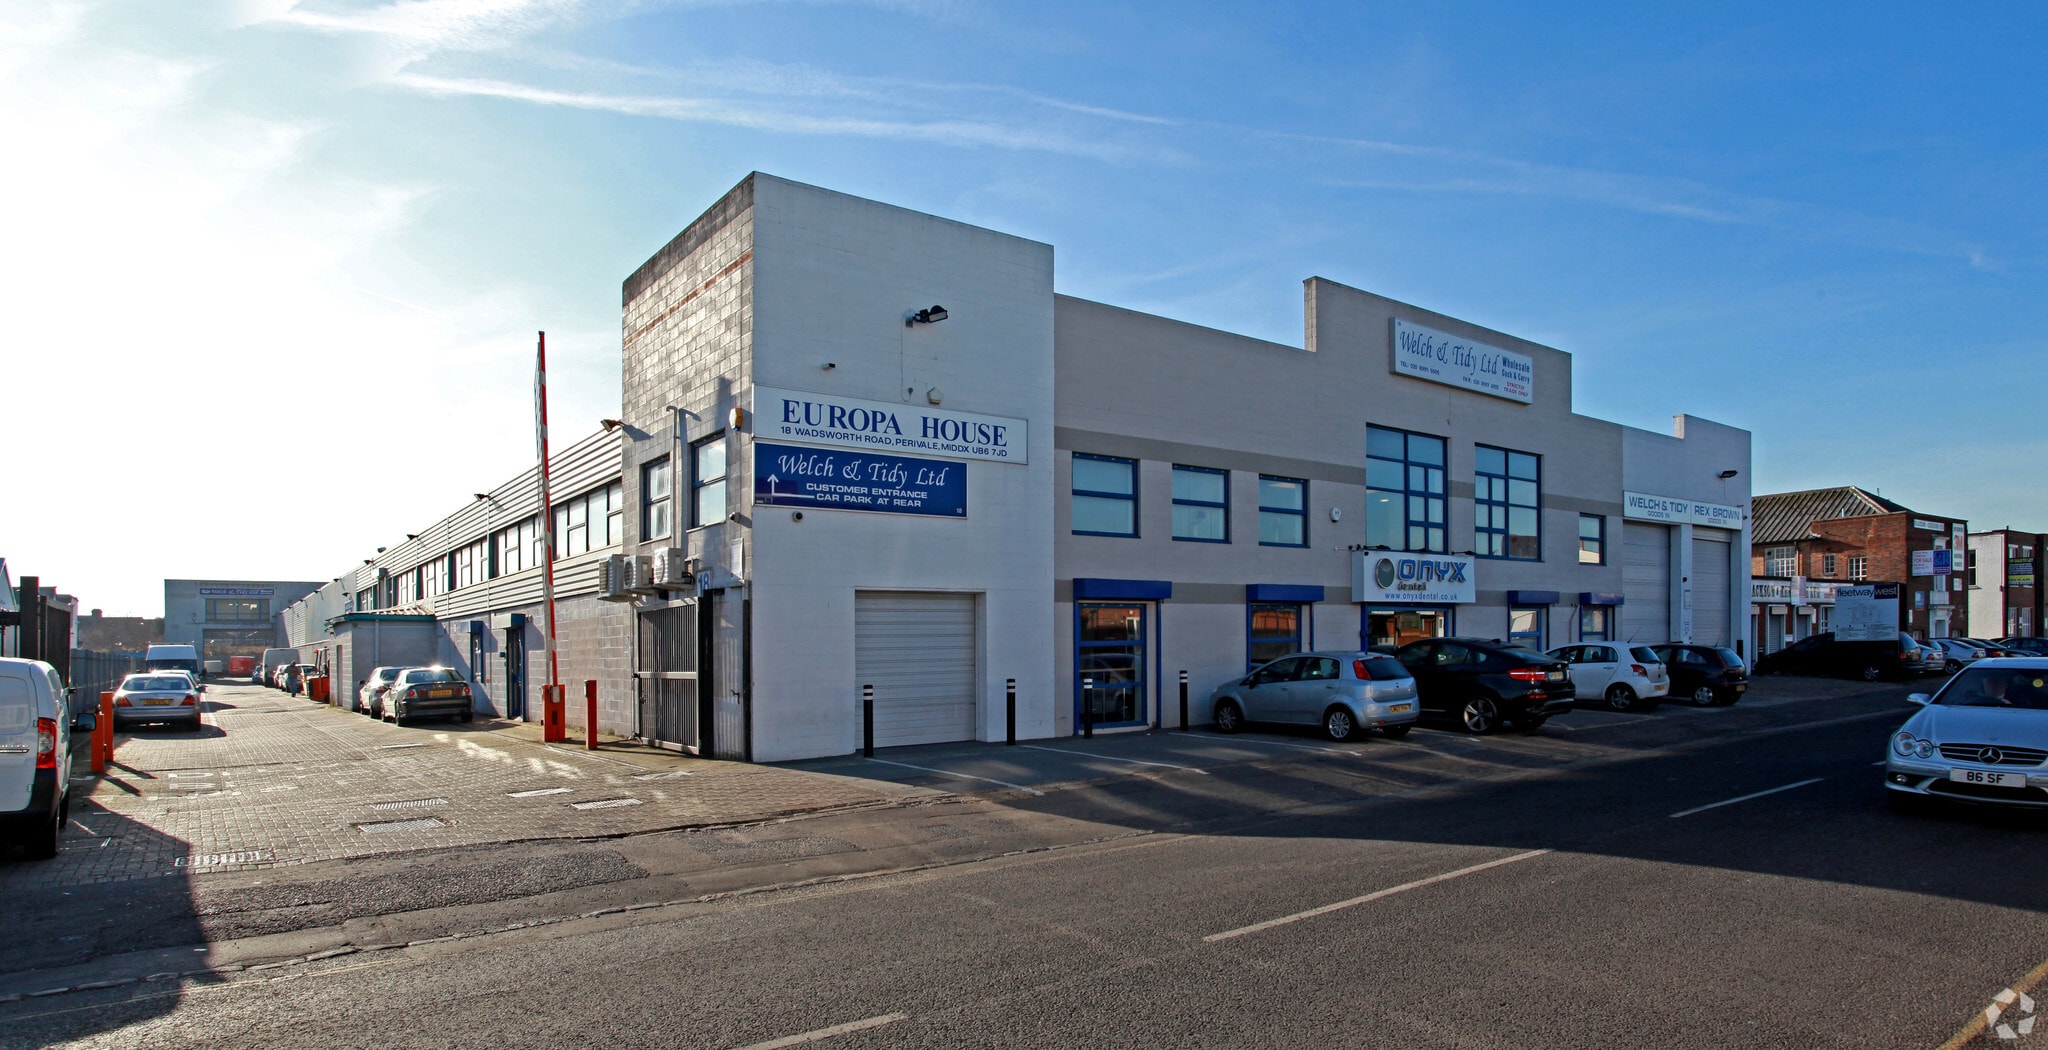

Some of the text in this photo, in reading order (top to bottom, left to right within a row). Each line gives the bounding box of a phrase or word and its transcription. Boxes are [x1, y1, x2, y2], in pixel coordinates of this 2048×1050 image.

[1400, 331, 1500, 375] Welch & Tidy Ltd
[1502, 356, 1530, 373] Wholesale
[1502, 369, 1513, 380] Cash
[1518, 373, 1530, 385] Carry
[1503, 387, 1529, 397] TRADE ONLY
[1506, 381, 1525, 390] STRICTLY
[781, 399, 1008, 447] EUROPA HOUSE
[781, 427, 1008, 457] 18 WADSWORTH ROAD, PERIVALE, MIDDX UB6 7JD
[778, 453, 949, 489] Welch & Tidy Ltd
[806, 482, 928, 499] CUSTOMER ENTRANCE
[816, 493, 921, 507] CAR PARK AT REAR
[1628, 496, 1688, 514] WELCH & TIDY
[1647, 510, 1664, 518] GOODS
[1694, 505, 1740, 520] REX BROWN
[698, 572, 710, 592] 18
[1398, 581, 1427, 591] dental
[1384, 592, 1458, 600] www.onyxdental.co.uk
[1752, 584, 1775, 598] ACKSON
[1966, 771, 2005, 784] 86 SF
